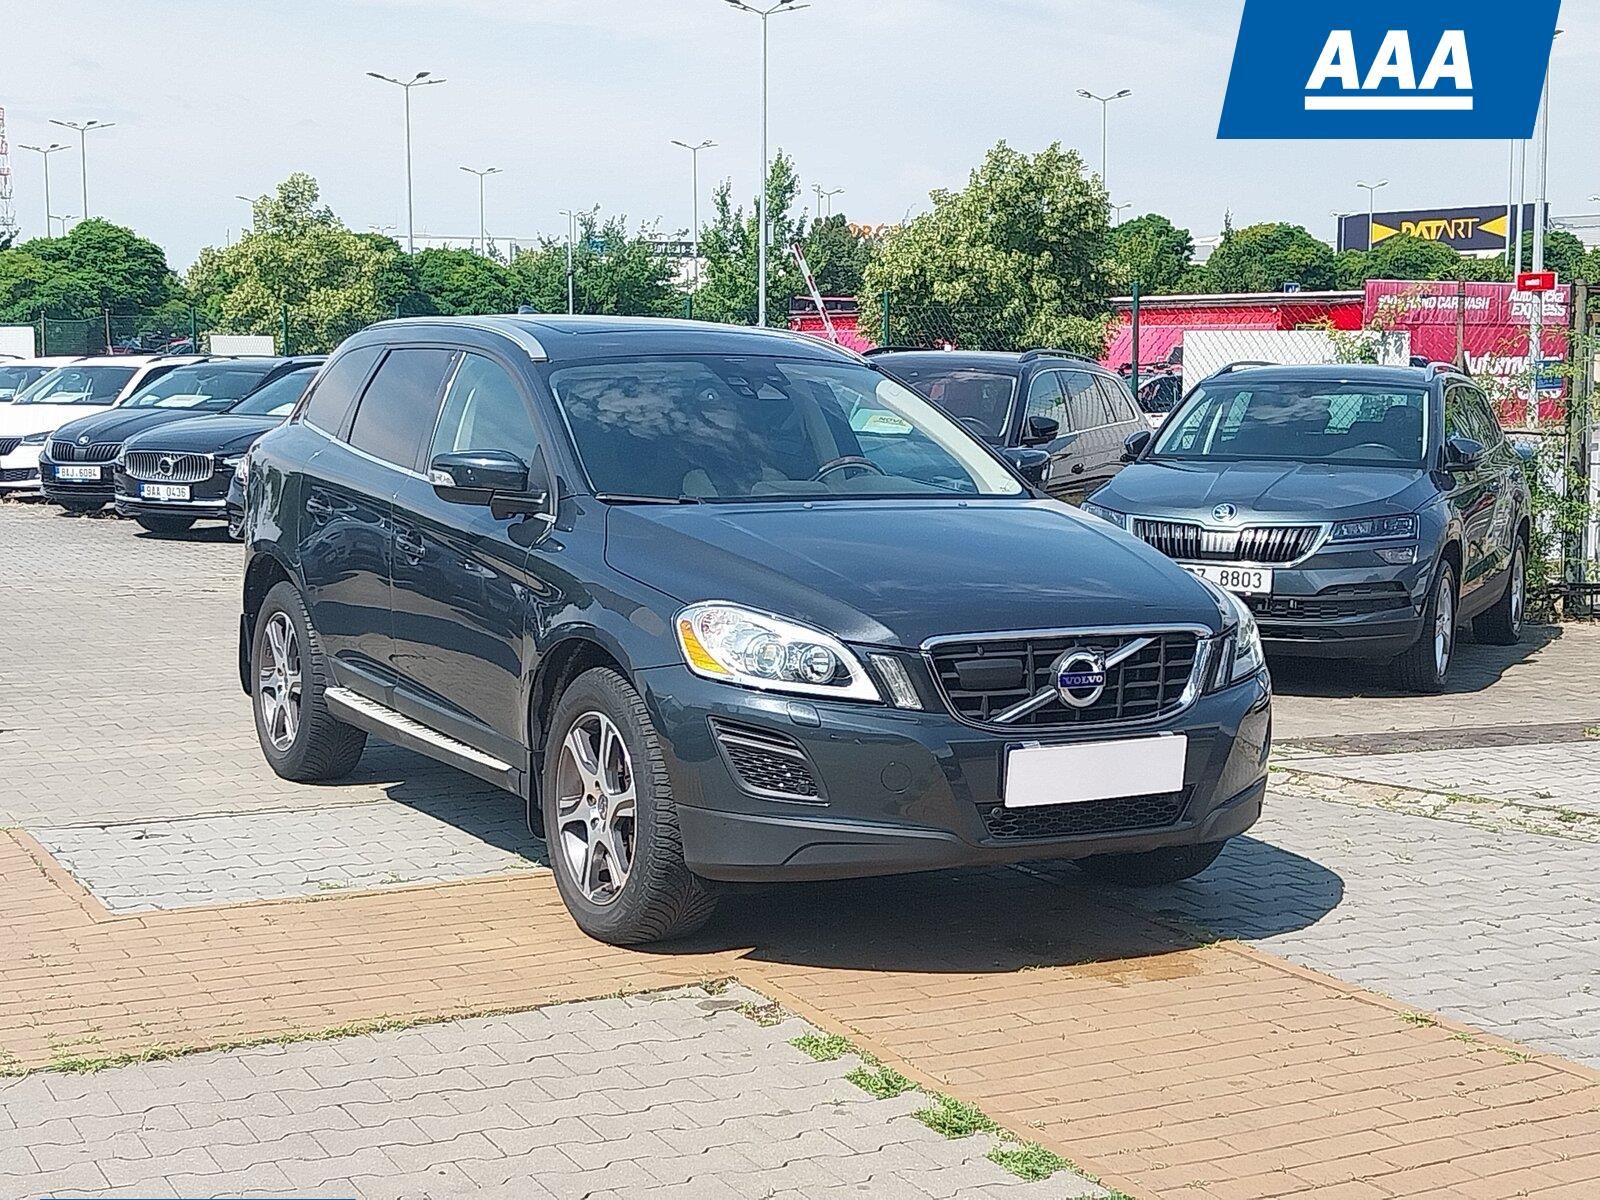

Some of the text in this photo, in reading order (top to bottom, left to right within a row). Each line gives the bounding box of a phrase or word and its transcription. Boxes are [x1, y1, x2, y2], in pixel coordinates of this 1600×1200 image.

[1401, 218, 1480, 240] DATART
[1437, 296, 1459, 309] CAR
[1220, 570, 1262, 589] 8803
[1062, 674, 1103, 685] VOLVO
